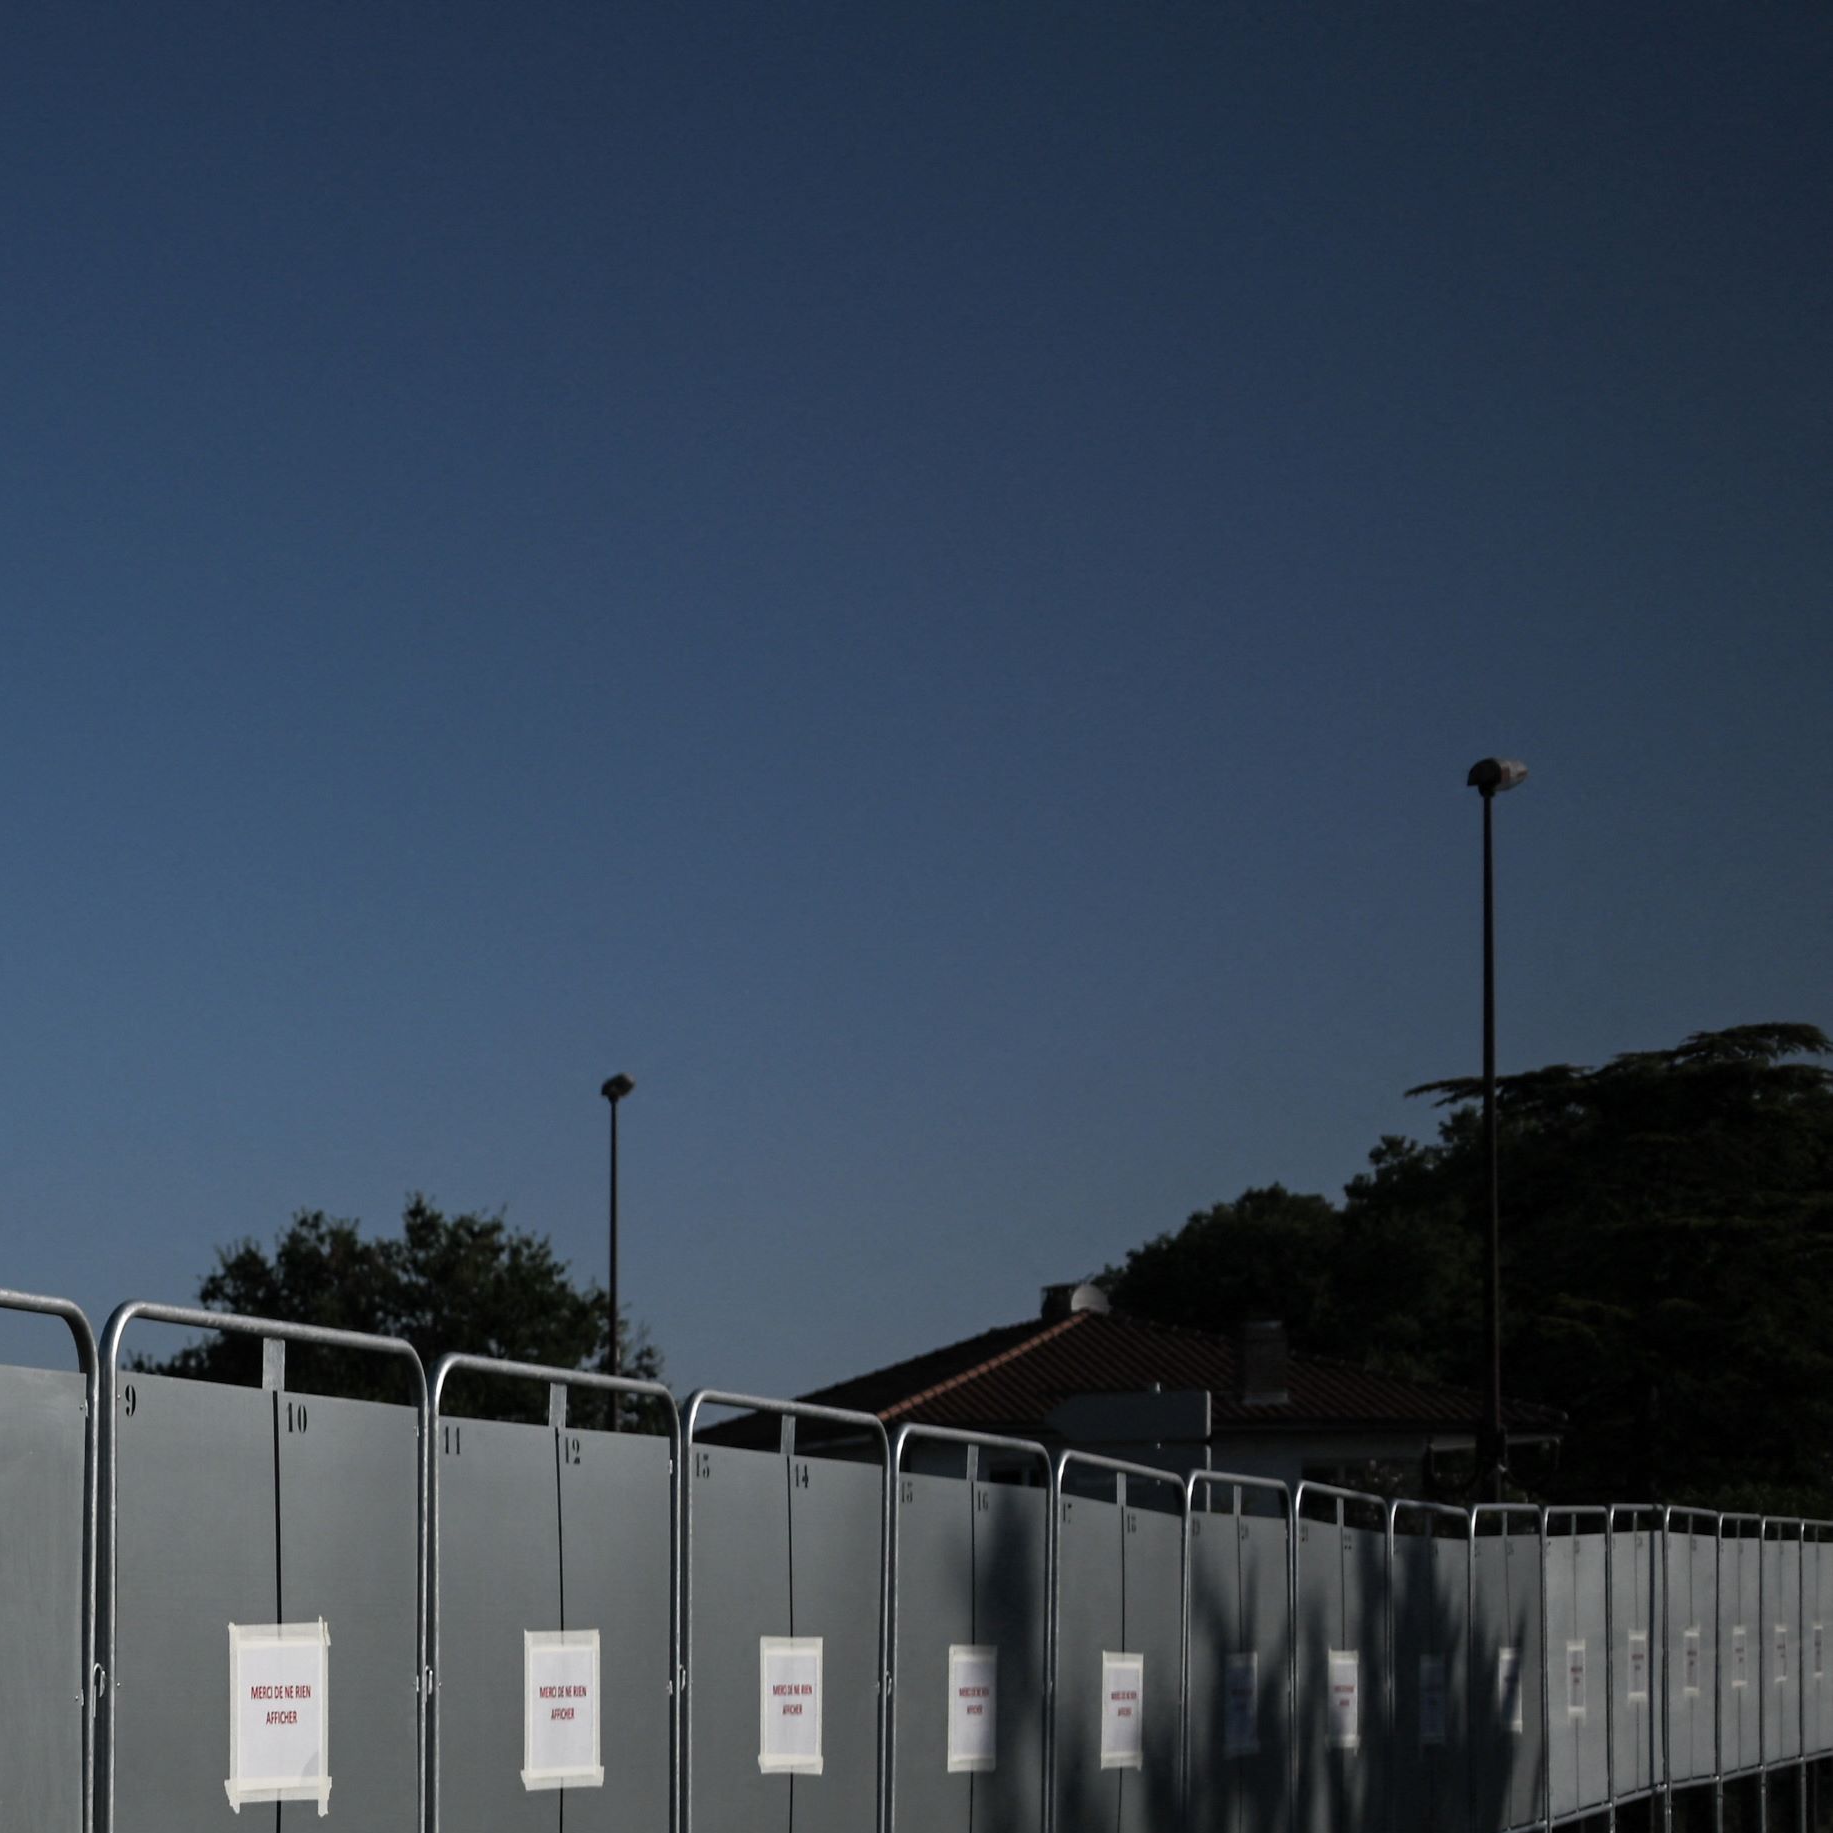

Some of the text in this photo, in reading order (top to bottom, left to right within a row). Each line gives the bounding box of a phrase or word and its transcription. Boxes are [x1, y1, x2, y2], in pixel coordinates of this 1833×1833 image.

[125, 1384, 136, 1417] 9
[286, 1402, 308, 1434] 10
[443, 1425, 461, 1456] 11
[565, 1437, 581, 1465] 12
[795, 1464, 809, 1489] 14
[251, 1685, 311, 1700] MERCI DE NE RIEN
[266, 1710, 297, 1725] AFFICHER
